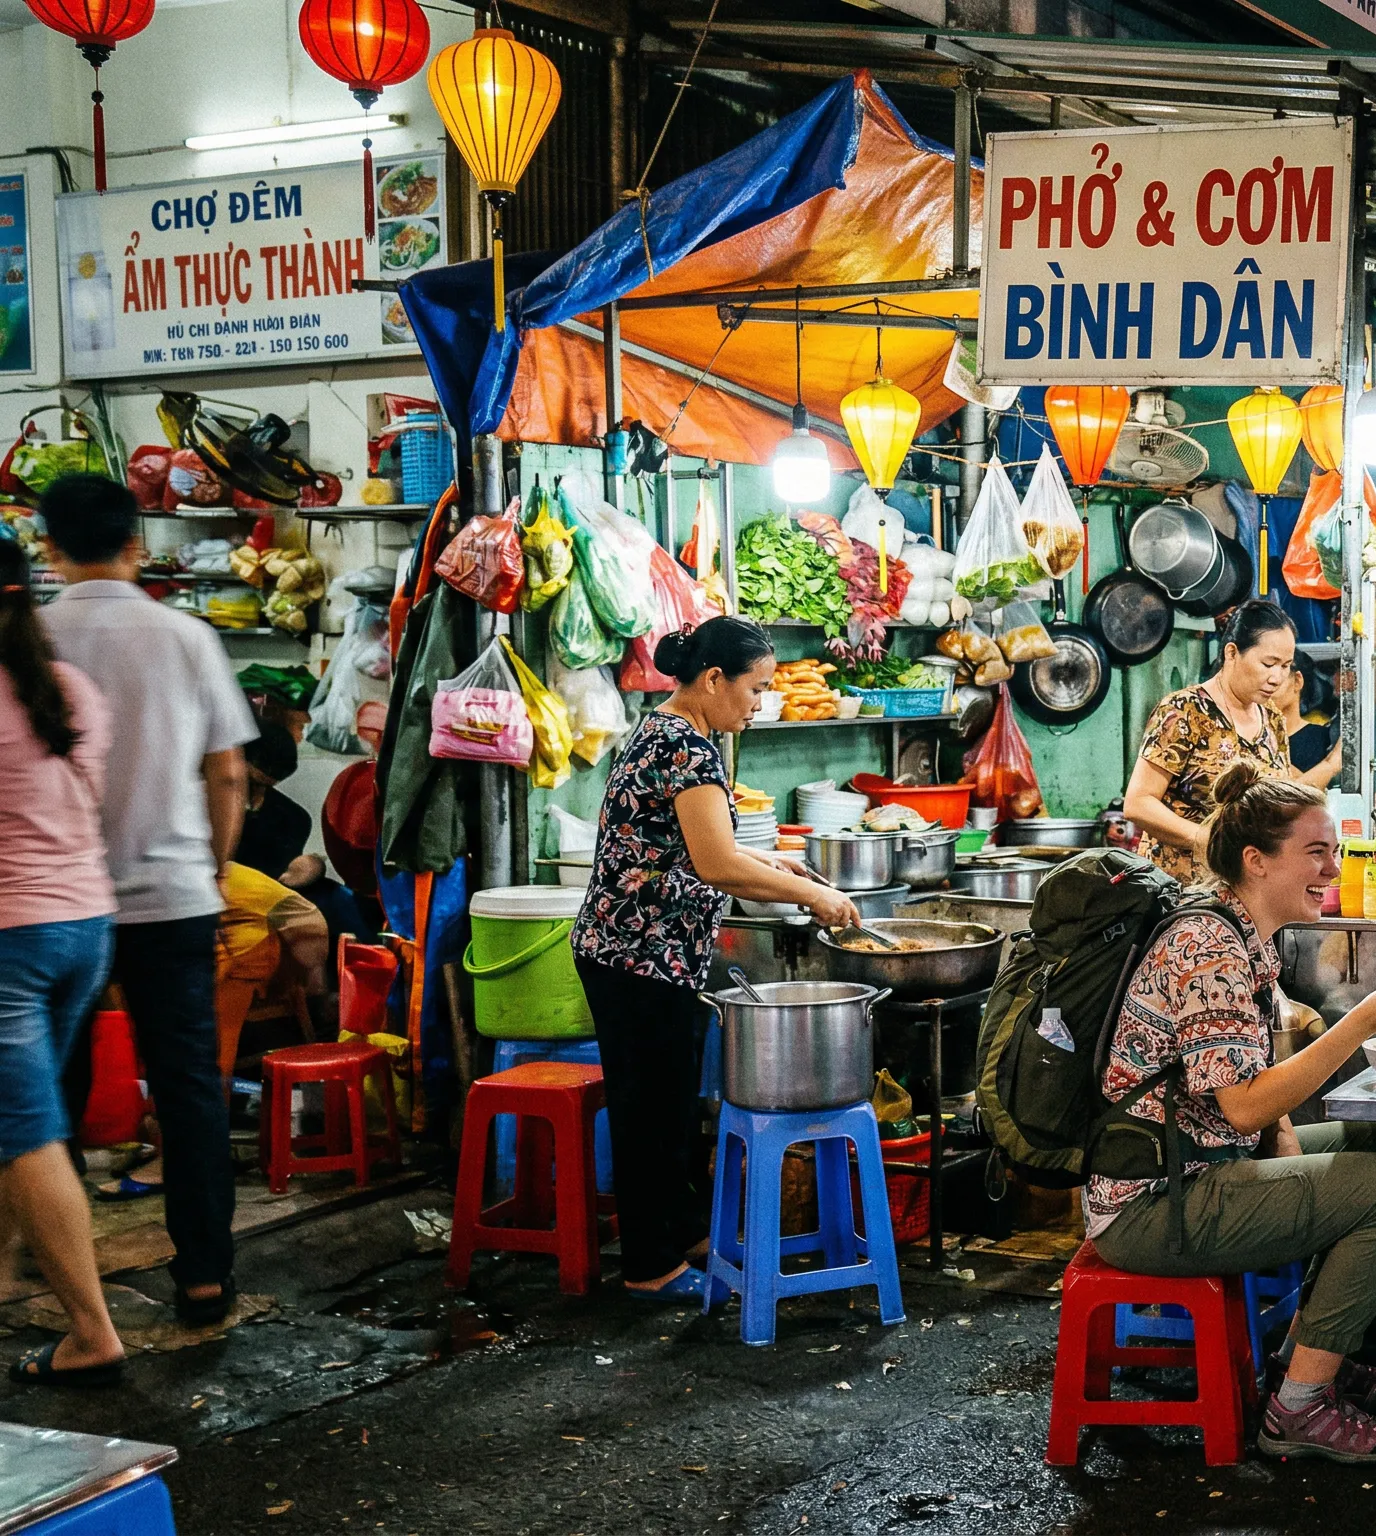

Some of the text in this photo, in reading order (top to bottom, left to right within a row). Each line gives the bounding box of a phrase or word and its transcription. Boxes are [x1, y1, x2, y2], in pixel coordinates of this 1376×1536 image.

[151, 180, 303, 234] CHỢ ĐÊM
[1000, 142, 1334, 251] PHỞ & CƠM
[122, 227, 365, 316] ẨM THỰC THÀNH
[1004, 257, 1315, 360] BÌNH DÂN
[269, 338, 292, 354] 150
[297, 336, 320, 351] 150
[324, 333, 349, 349] 600
